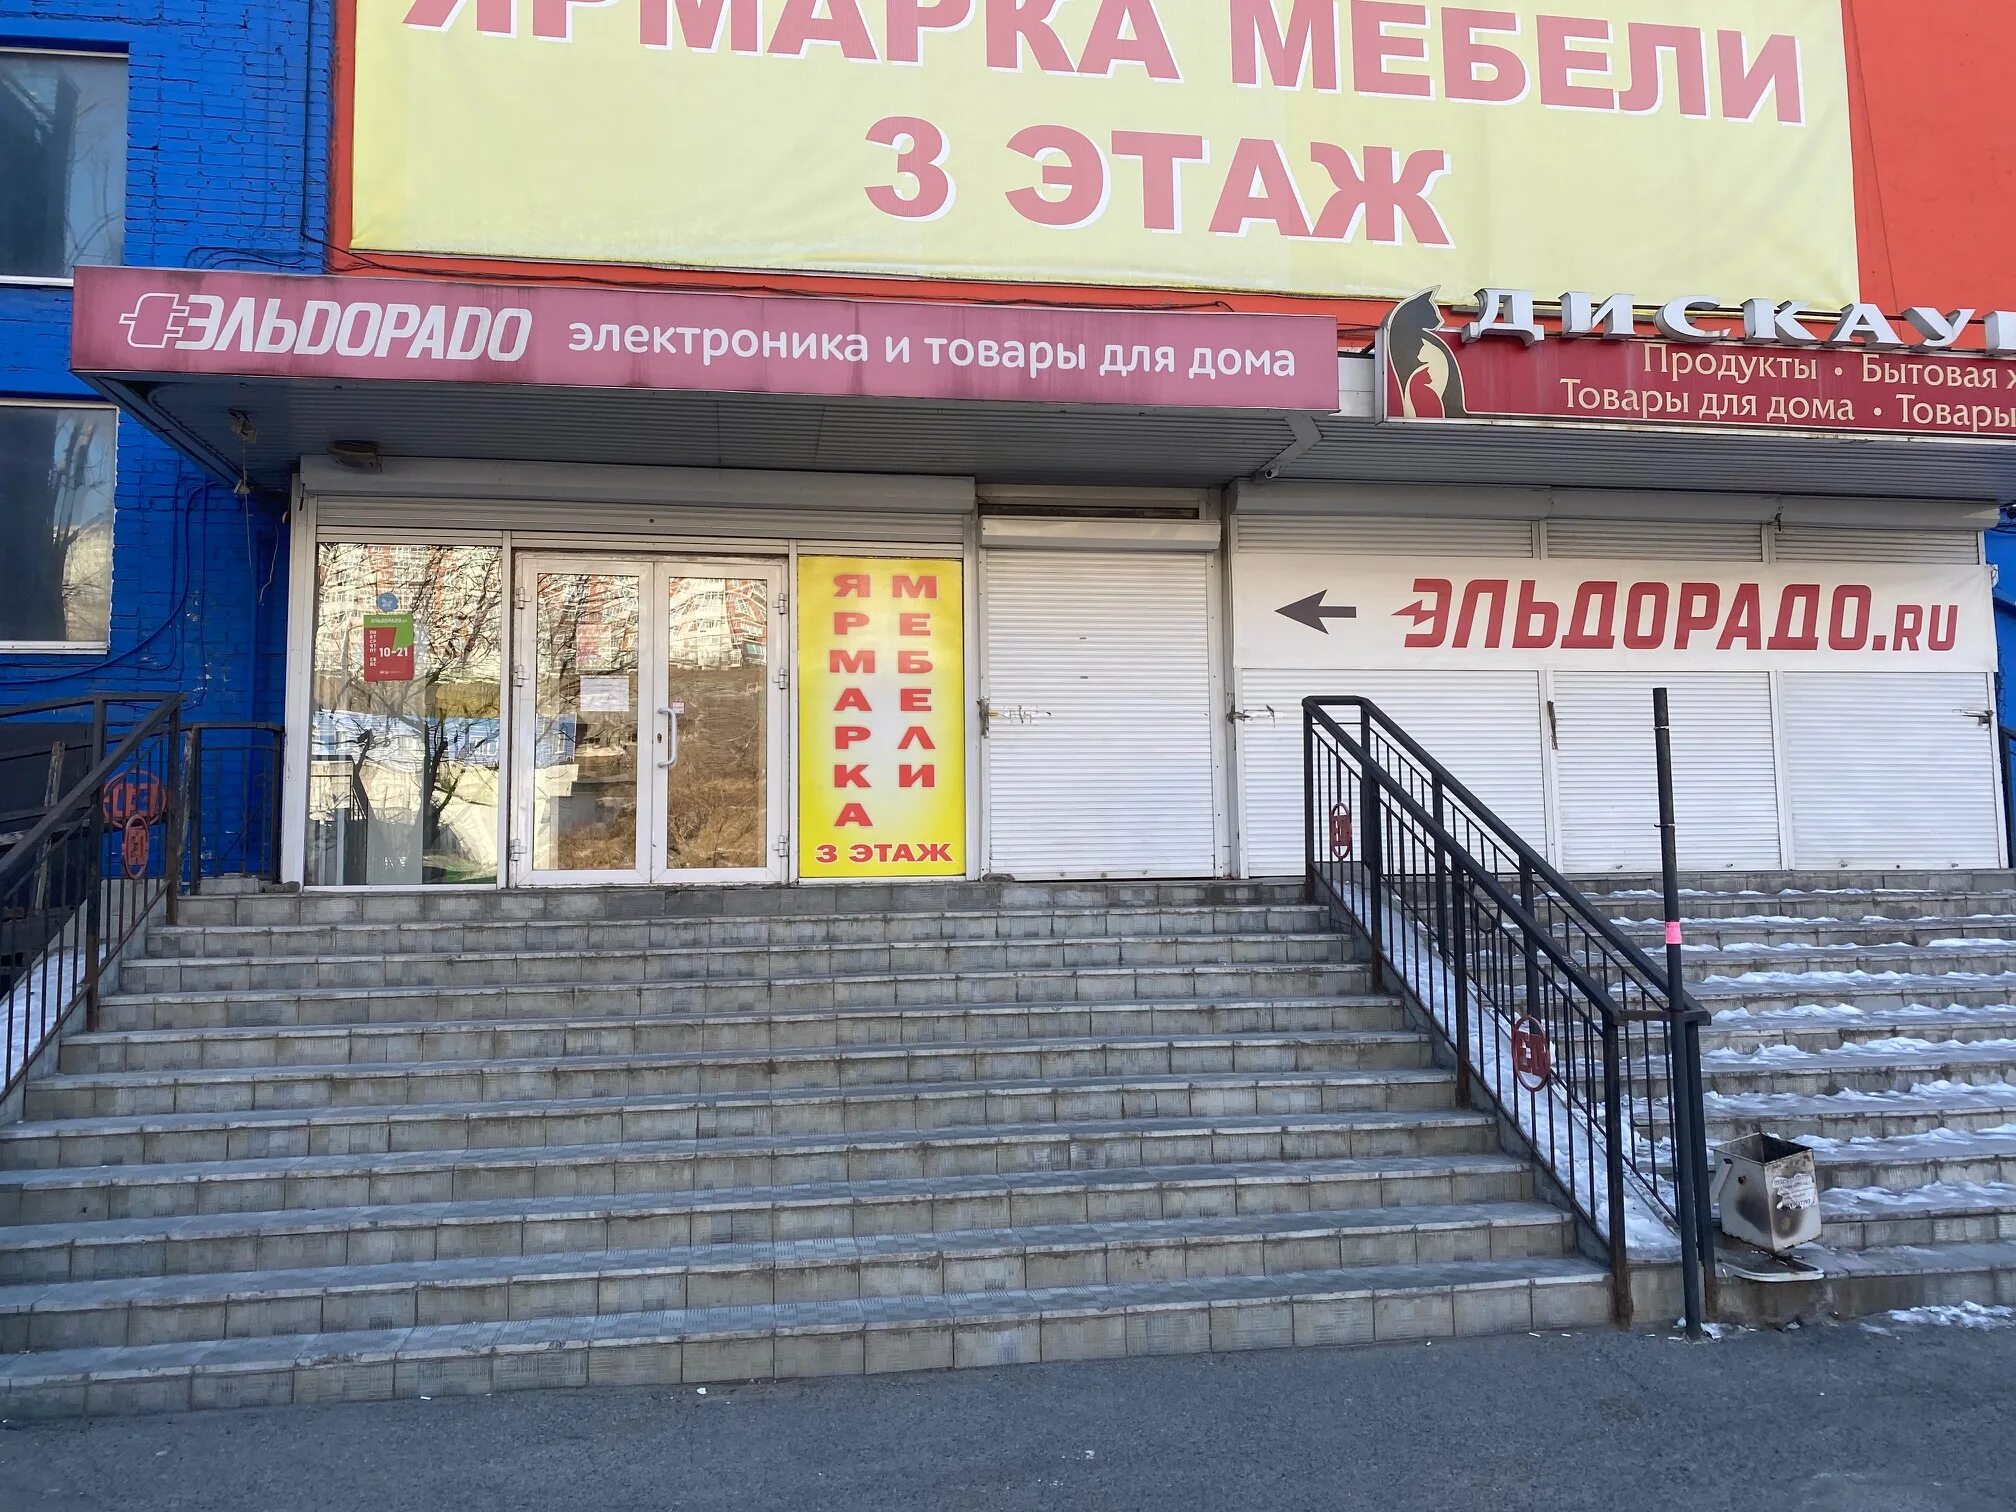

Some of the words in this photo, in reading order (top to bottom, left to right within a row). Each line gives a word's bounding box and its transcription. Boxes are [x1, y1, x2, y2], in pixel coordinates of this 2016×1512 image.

[1230, 0, 1806, 127] МЕБЕЛИ
[1005, 124, 1456, 249] ЭТАЖ
[567, 322, 869, 376] электроника
[885, 336, 910, 361] и
[923, 336, 1085, 379] товары
[1098, 343, 1176, 377] для
[1188, 345, 1296, 380] дома
[1643, 343, 1818, 383] Продукты
[1861, 353, 1998, 389] Бытовая
[1560, 377, 1690, 418] Товары
[1698, 392, 1759, 421] для
[1766, 396, 1856, 423] дома
[1895, 393, 2016, 433] Товары
[1404, 578, 1959, 652] ЭЛЬДОРАДО.RU
[379, 647, 408, 657] 10-21
[891, 575, 938, 788] МЕБЕЛИ
[828, 574, 876, 827] ЯРМАРКА
[848, 843, 954, 863] ЭТАЖ
